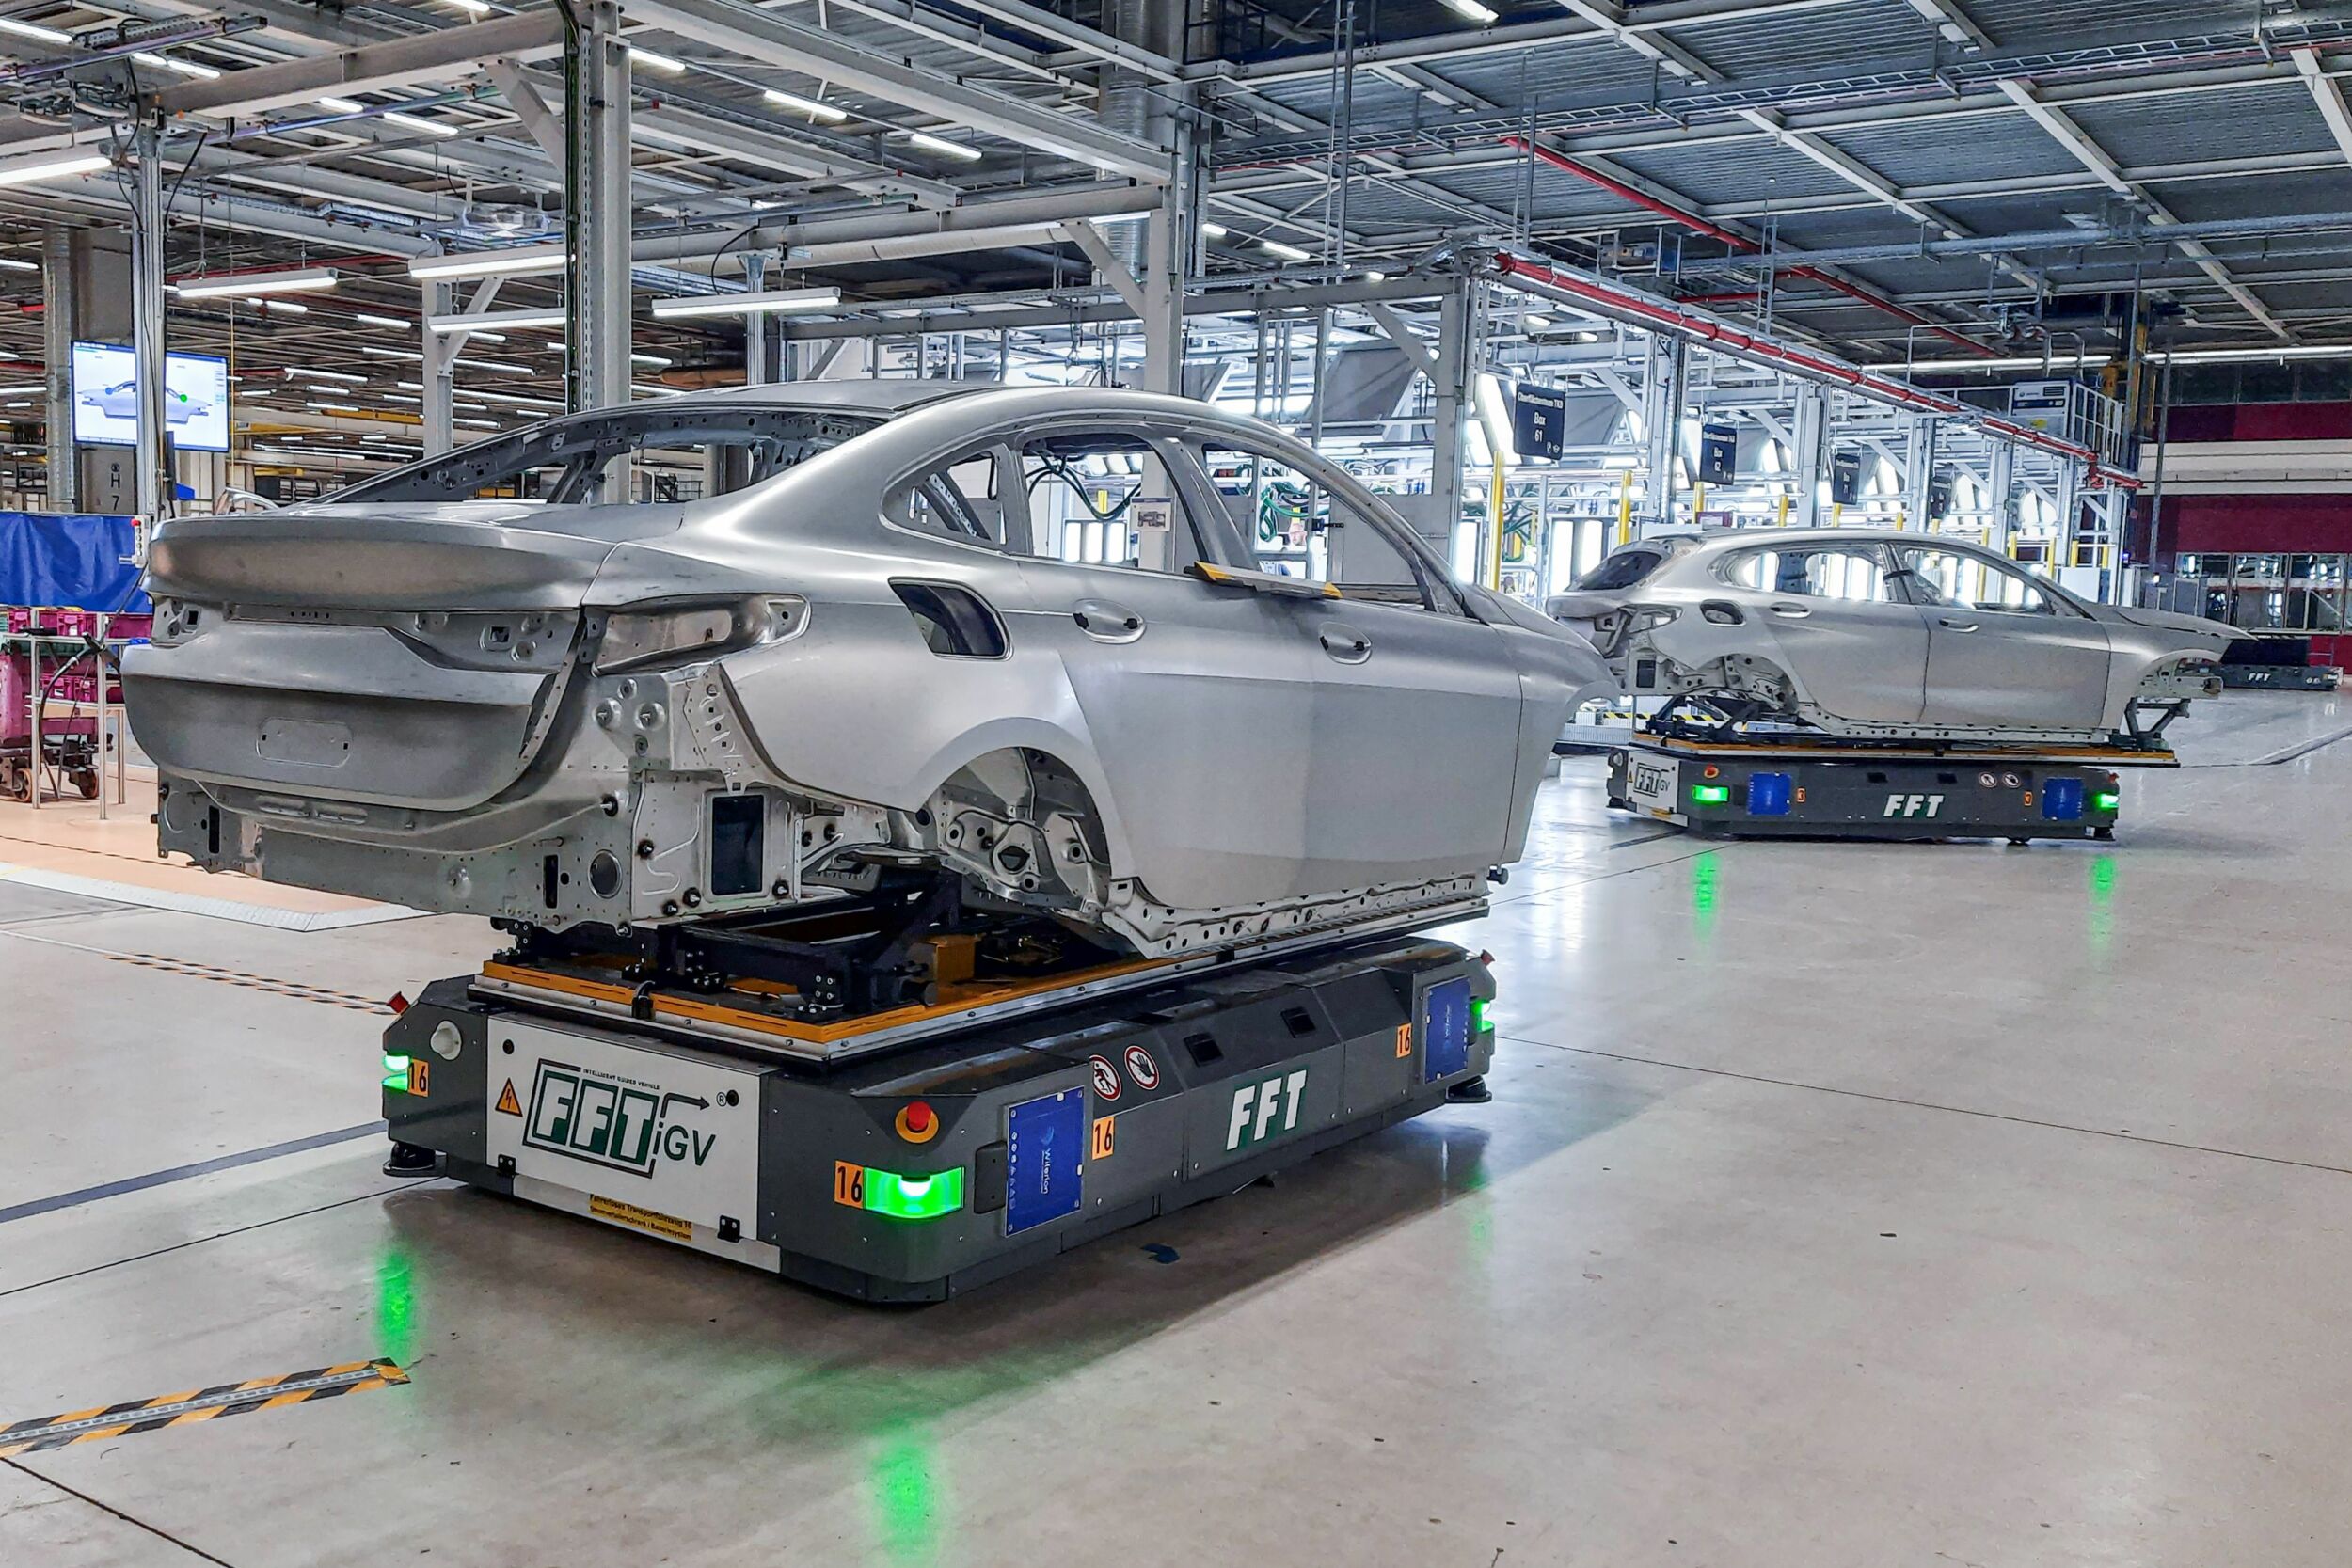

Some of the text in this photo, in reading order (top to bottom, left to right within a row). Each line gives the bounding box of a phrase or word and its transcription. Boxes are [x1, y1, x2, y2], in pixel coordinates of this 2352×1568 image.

[1534, 411, 1546, 425] Box
[1534, 429, 1543, 442] 61
[110, 473, 120, 489] H
[112, 495, 120, 511] 7
[1883, 794, 1945, 817] FFT
[1398, 1026, 1410, 1054] 16
[408, 1063, 427, 1093] 16
[533, 1073, 657, 1164] FFT
[1226, 1069, 1307, 1151] FFT
[1094, 1120, 1112, 1155] 16
[837, 1166, 863, 1202] 16
